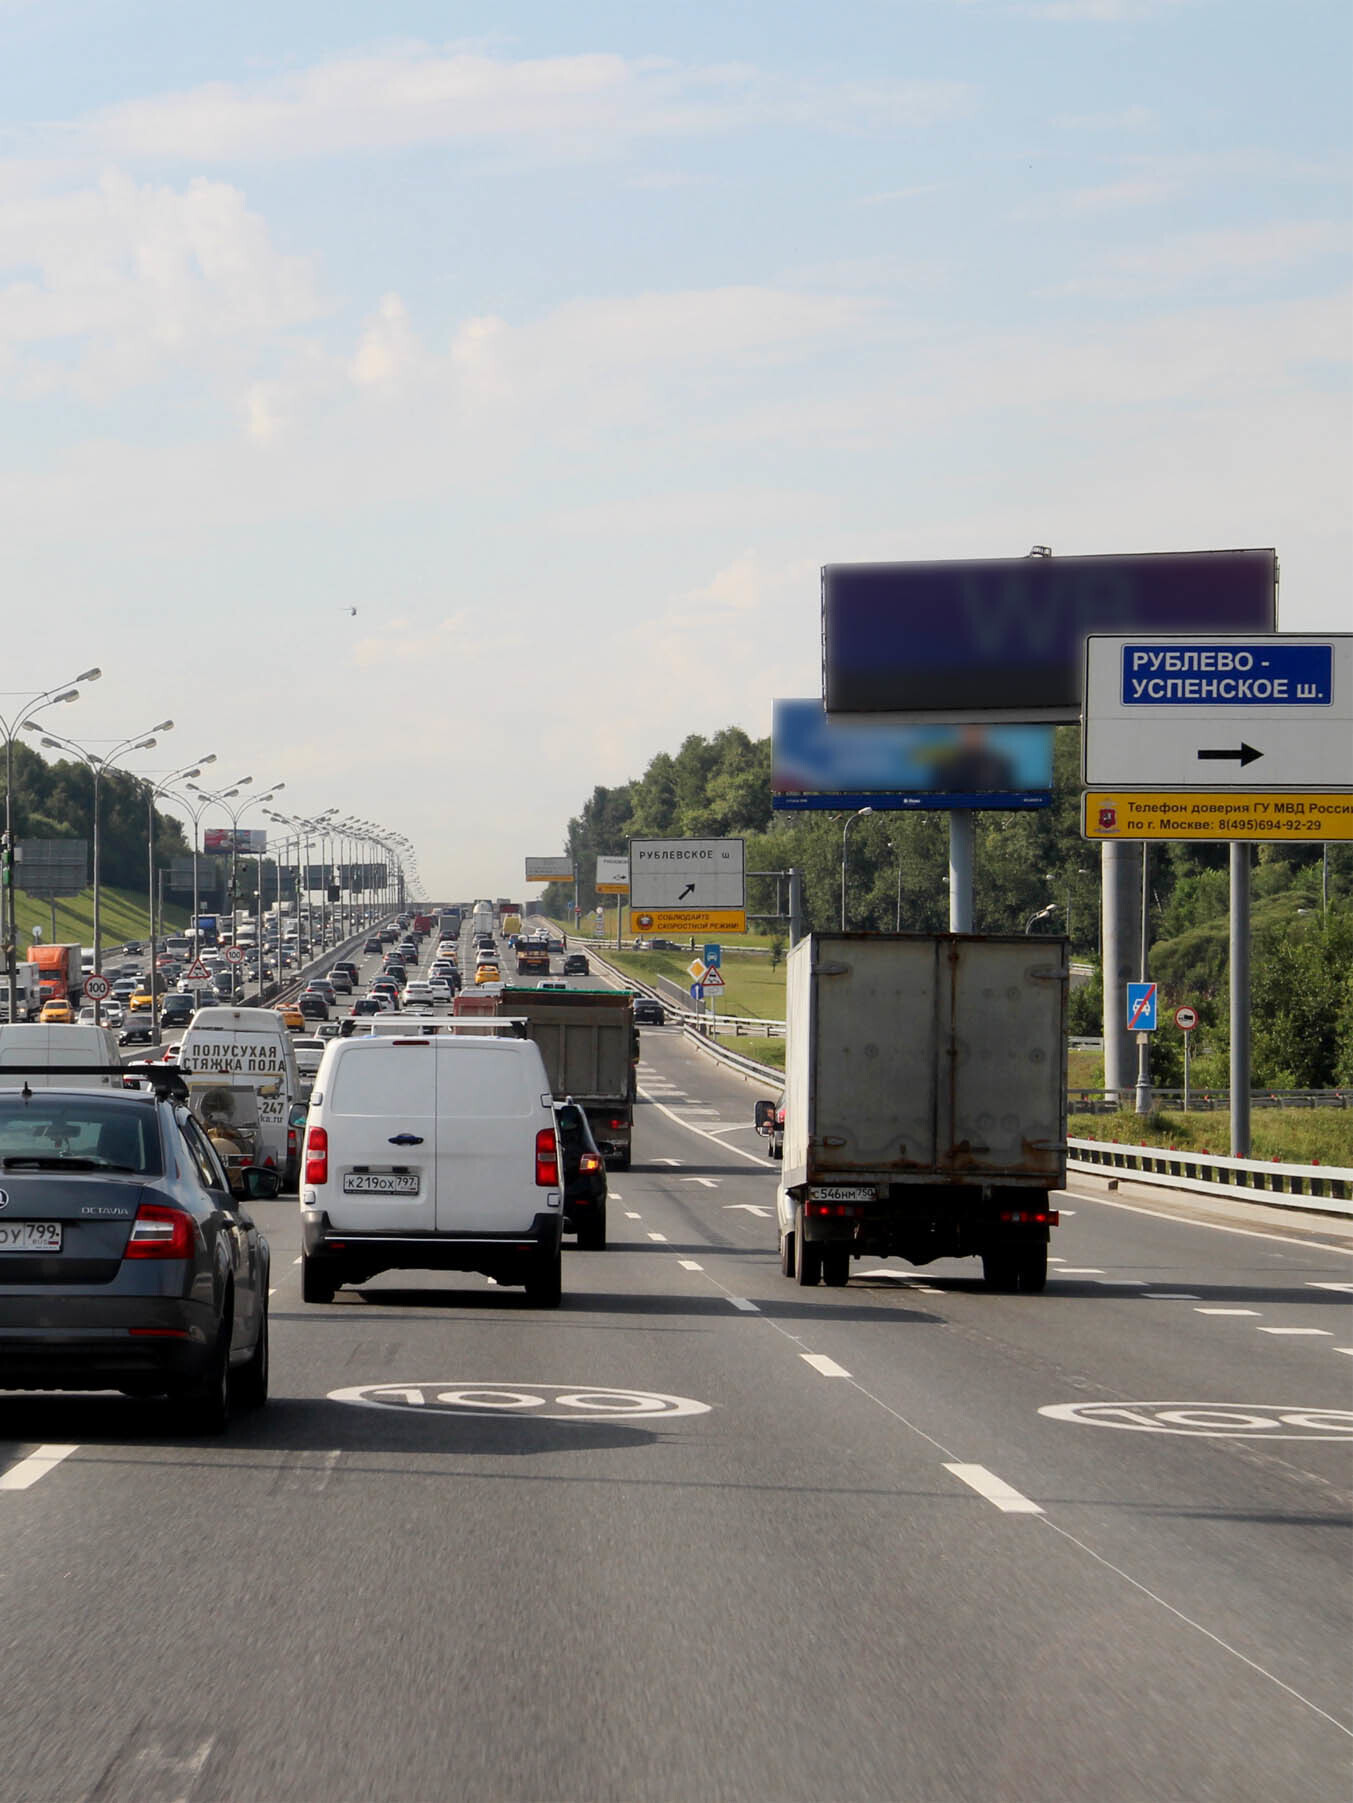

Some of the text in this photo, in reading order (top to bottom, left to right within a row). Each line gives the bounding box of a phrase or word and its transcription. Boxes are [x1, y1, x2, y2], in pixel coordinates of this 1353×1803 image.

[1132, 651, 1254, 671] РУБЛЕВО
[1131, 678, 1323, 699] УСПЕНСКОЕ ш.
[1127, 801, 1353, 816] Телефон доверия ГУ МВД Росси
[1127, 818, 1322, 832] по г. Москве: 8(495)694-92-29
[639, 850, 713, 860] РУБЛЕВСКОЕ
[89, 982, 106, 993] 100
[192, 1044, 277, 1059] ПОЛУСУХАЯ
[183, 1058, 287, 1073] СТЯЖКА ПОЛА
[397, 1176, 415, 1186] 797
[81, 1207, 129, 1216] OCTAVIA
[26, 1224, 58, 1239] 799
[373, 1390, 668, 1412] 100
